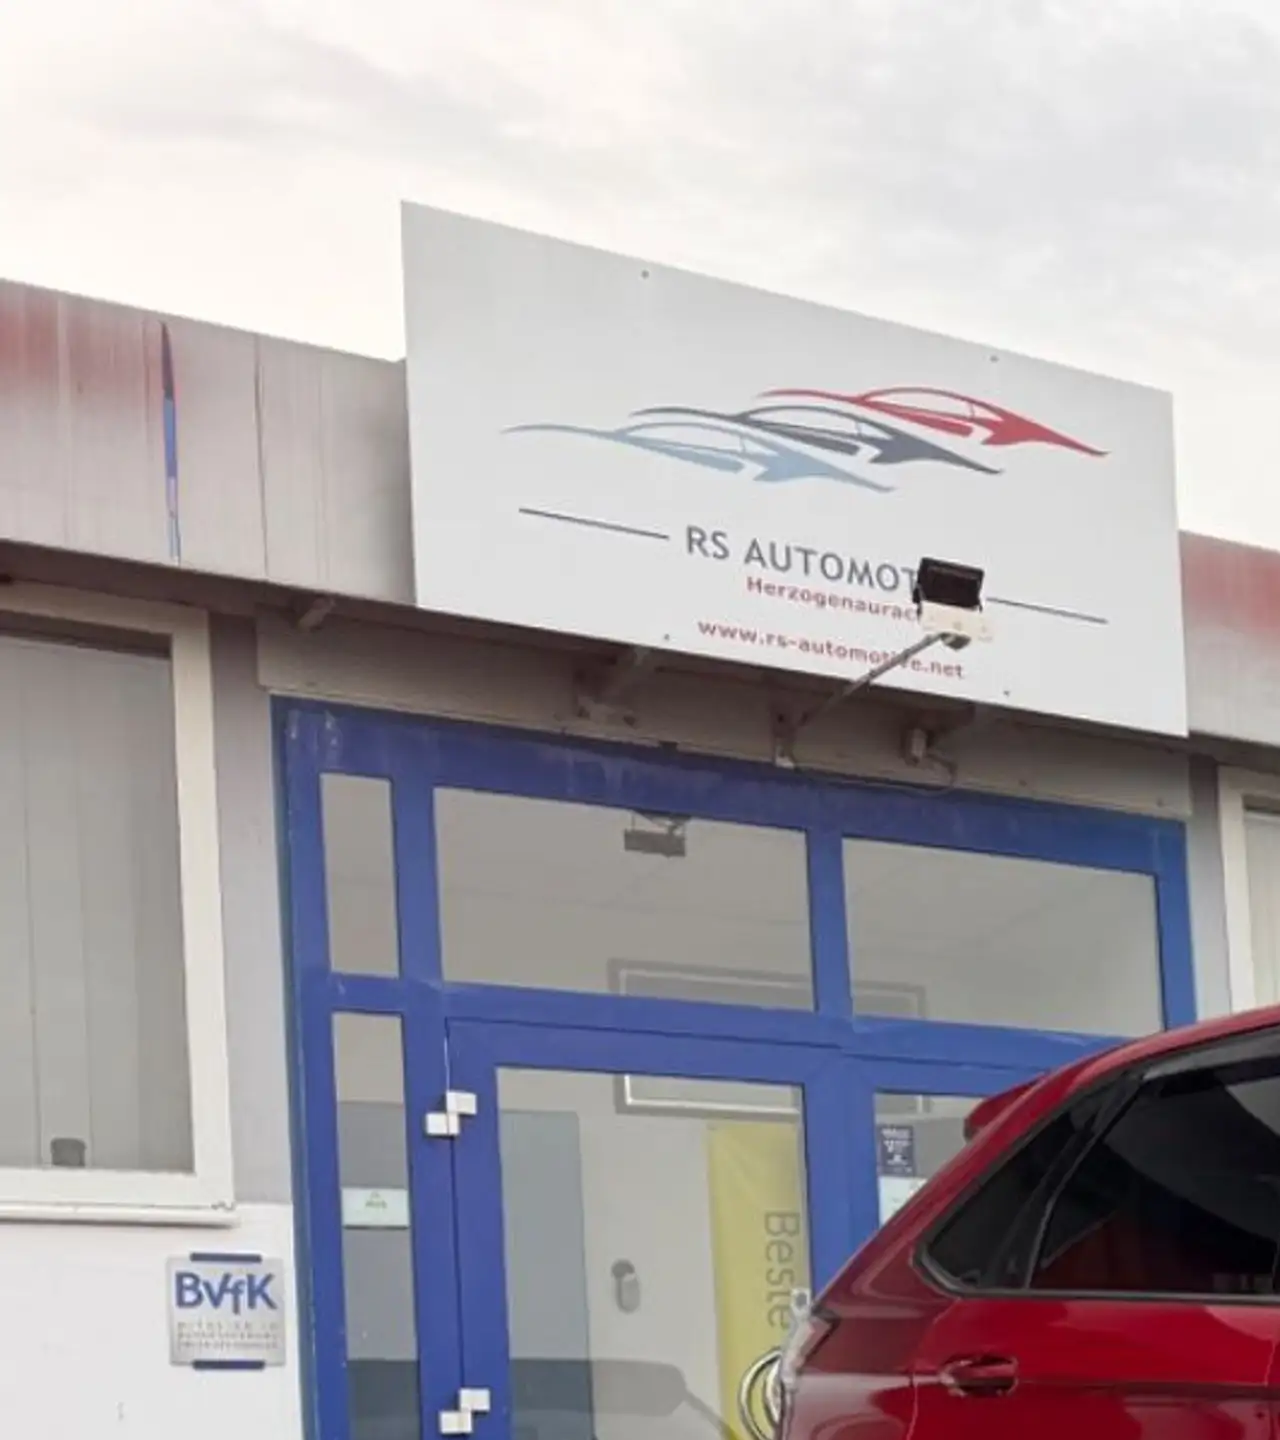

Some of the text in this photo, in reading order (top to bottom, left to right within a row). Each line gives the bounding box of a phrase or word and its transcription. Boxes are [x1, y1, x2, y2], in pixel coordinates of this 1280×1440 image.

[686, 525, 918, 594] RS AUTOMOT
[746, 575, 919, 622] Herzogenaurac
[764, 1211, 800, 1331] Beste
